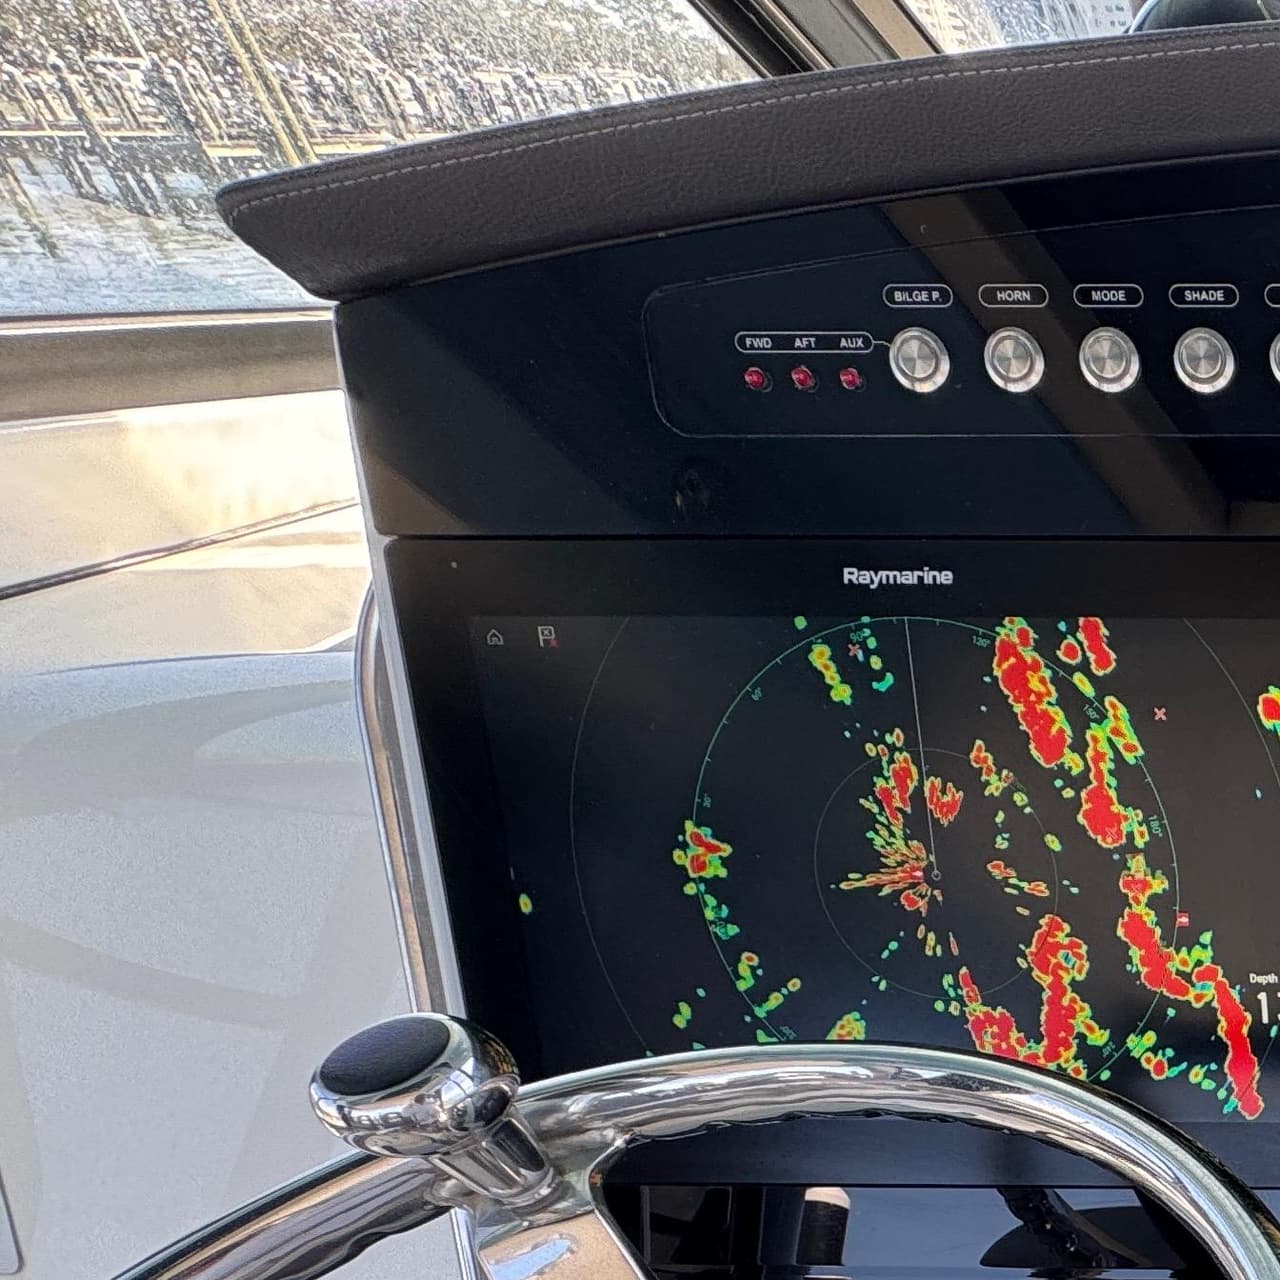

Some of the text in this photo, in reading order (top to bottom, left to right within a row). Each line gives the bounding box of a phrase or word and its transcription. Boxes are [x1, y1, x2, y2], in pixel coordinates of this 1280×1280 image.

[894, 290, 929, 302] BILGE
[996, 290, 1031, 301] HORN
[1091, 290, 1126, 302] MODE
[1184, 289, 1225, 302] SHADE
[745, 337, 865, 349] FWD AFT AUX
[843, 567, 954, 589] Raymarine
[1249, 973, 1278, 984] Depth
